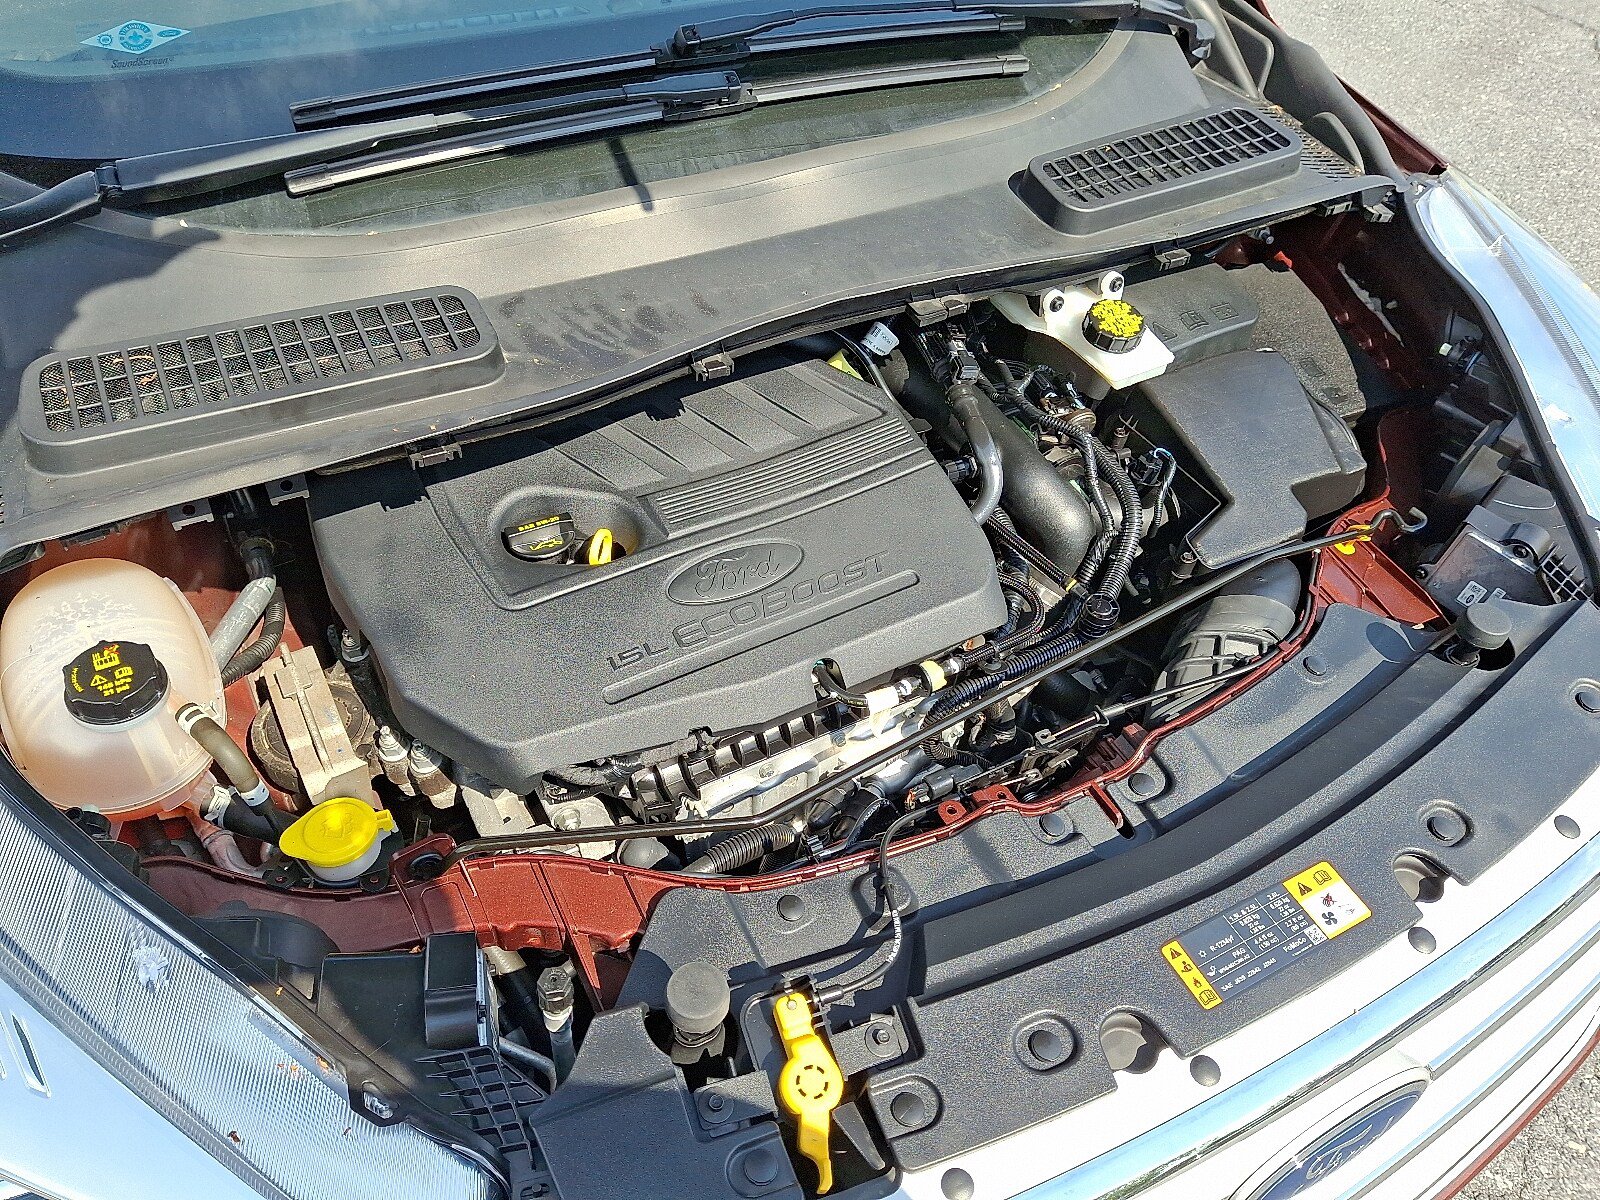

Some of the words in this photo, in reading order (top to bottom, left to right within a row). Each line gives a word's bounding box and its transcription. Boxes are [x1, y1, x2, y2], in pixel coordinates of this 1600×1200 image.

[518, 523, 536, 531] SAE
[536, 516, 560, 527] 5W-20
[695, 550, 782, 598] Ford
[606, 641, 669, 672] 1.5L
[671, 550, 889, 648] ECOBOOST
[1282, 937, 1307, 953] FoMoCo
[1231, 947, 1246, 959] PAG
[1220, 981, 1234, 992] SAE
